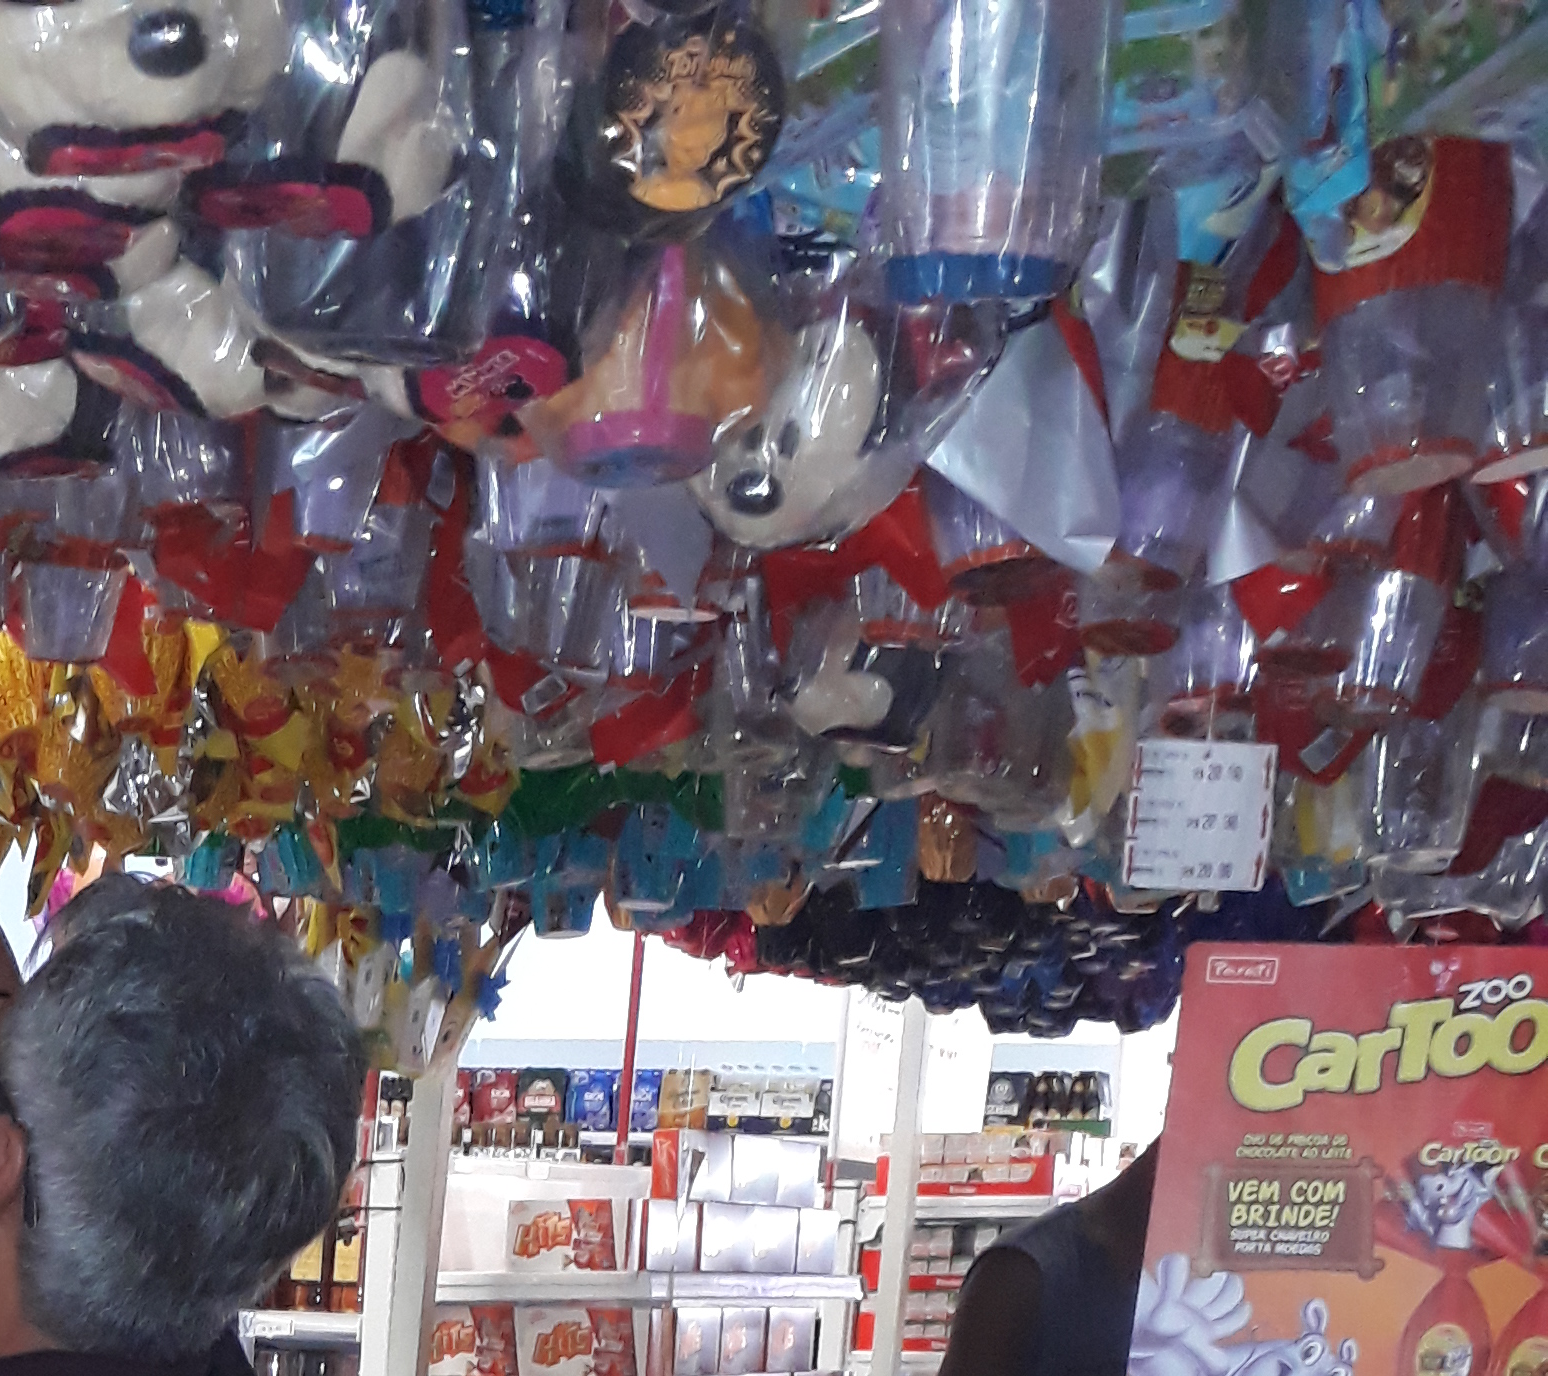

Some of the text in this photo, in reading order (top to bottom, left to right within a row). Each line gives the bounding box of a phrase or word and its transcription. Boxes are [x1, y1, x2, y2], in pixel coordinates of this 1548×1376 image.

[1228, 998, 1548, 1113] CarToo
[1228, 1179, 1346, 1203] VEM COM
[1229, 1203, 1340, 1228] BRINDE!
